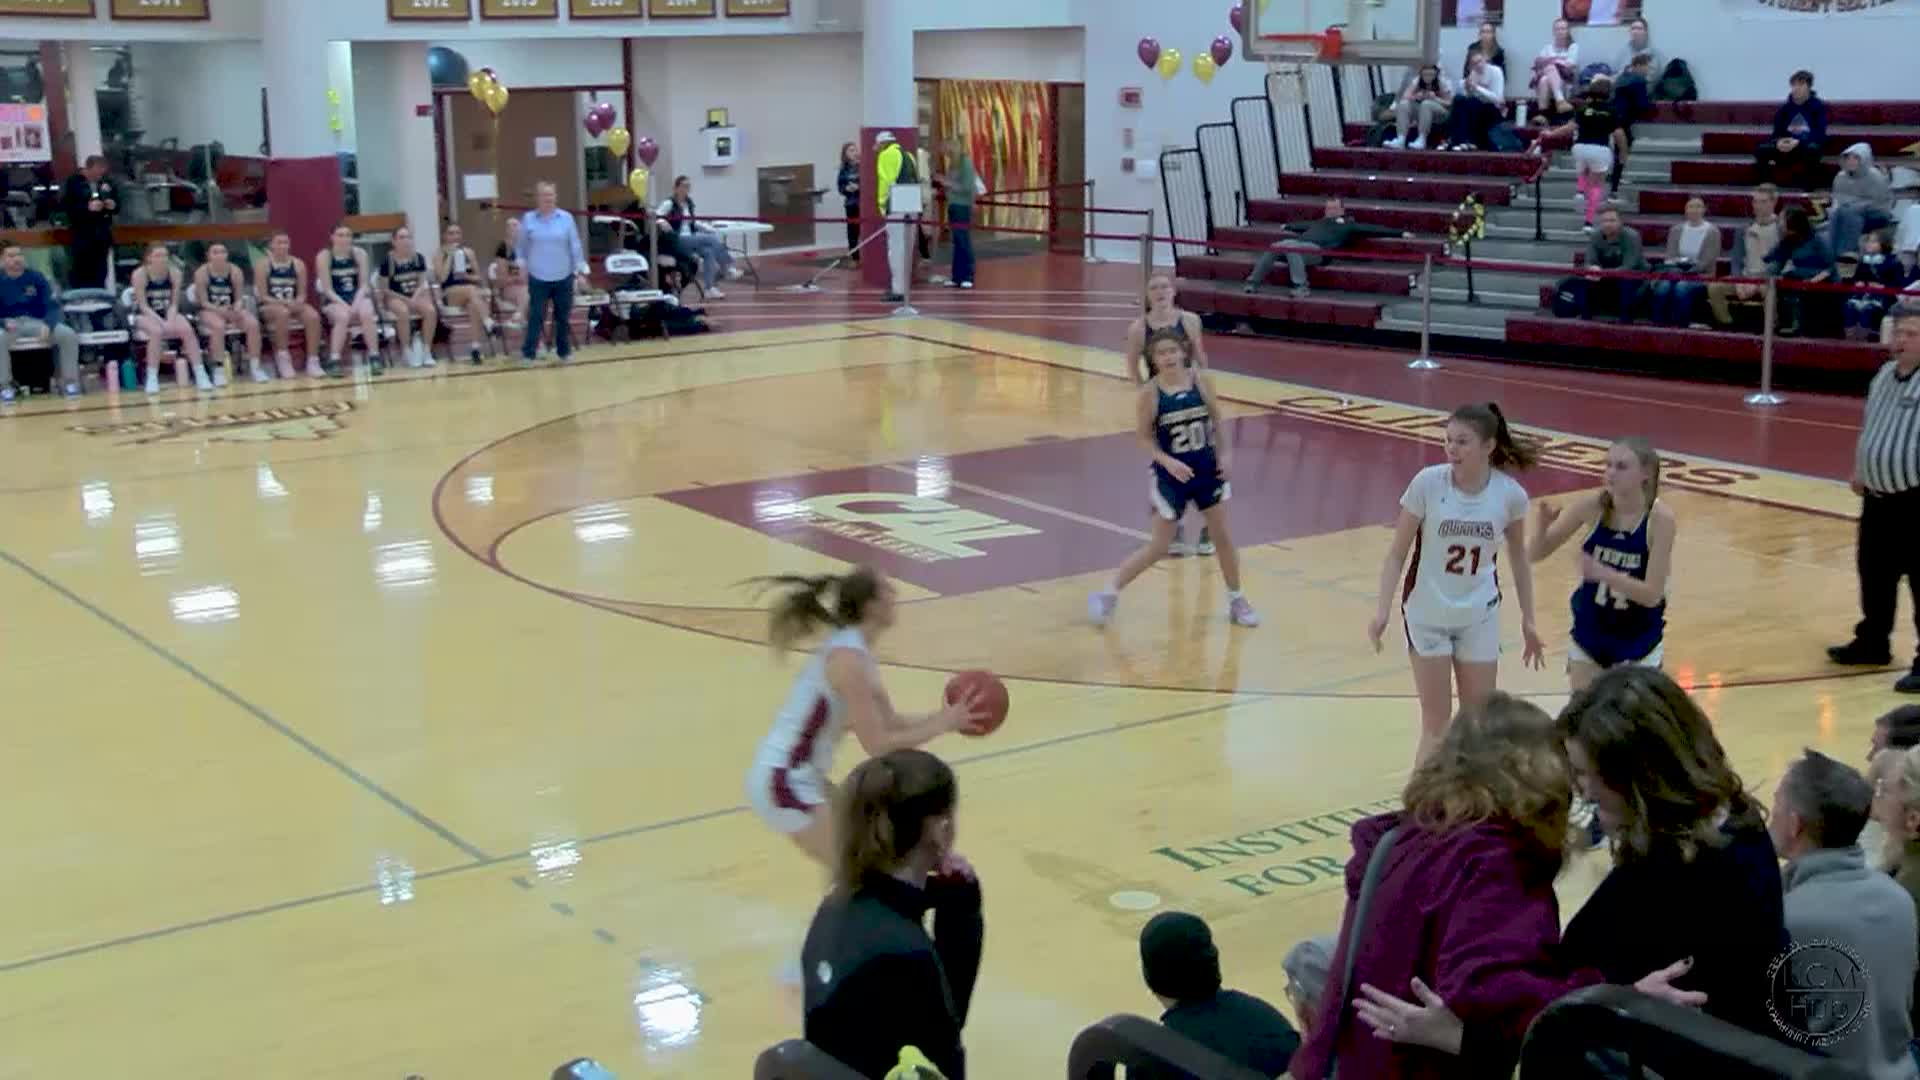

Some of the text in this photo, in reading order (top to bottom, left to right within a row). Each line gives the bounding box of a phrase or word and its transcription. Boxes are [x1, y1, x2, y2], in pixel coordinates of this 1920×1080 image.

[1168, 421, 1207, 454] 20
[1445, 543, 1482, 576] 21
[1222, 855, 1347, 897] FOR
